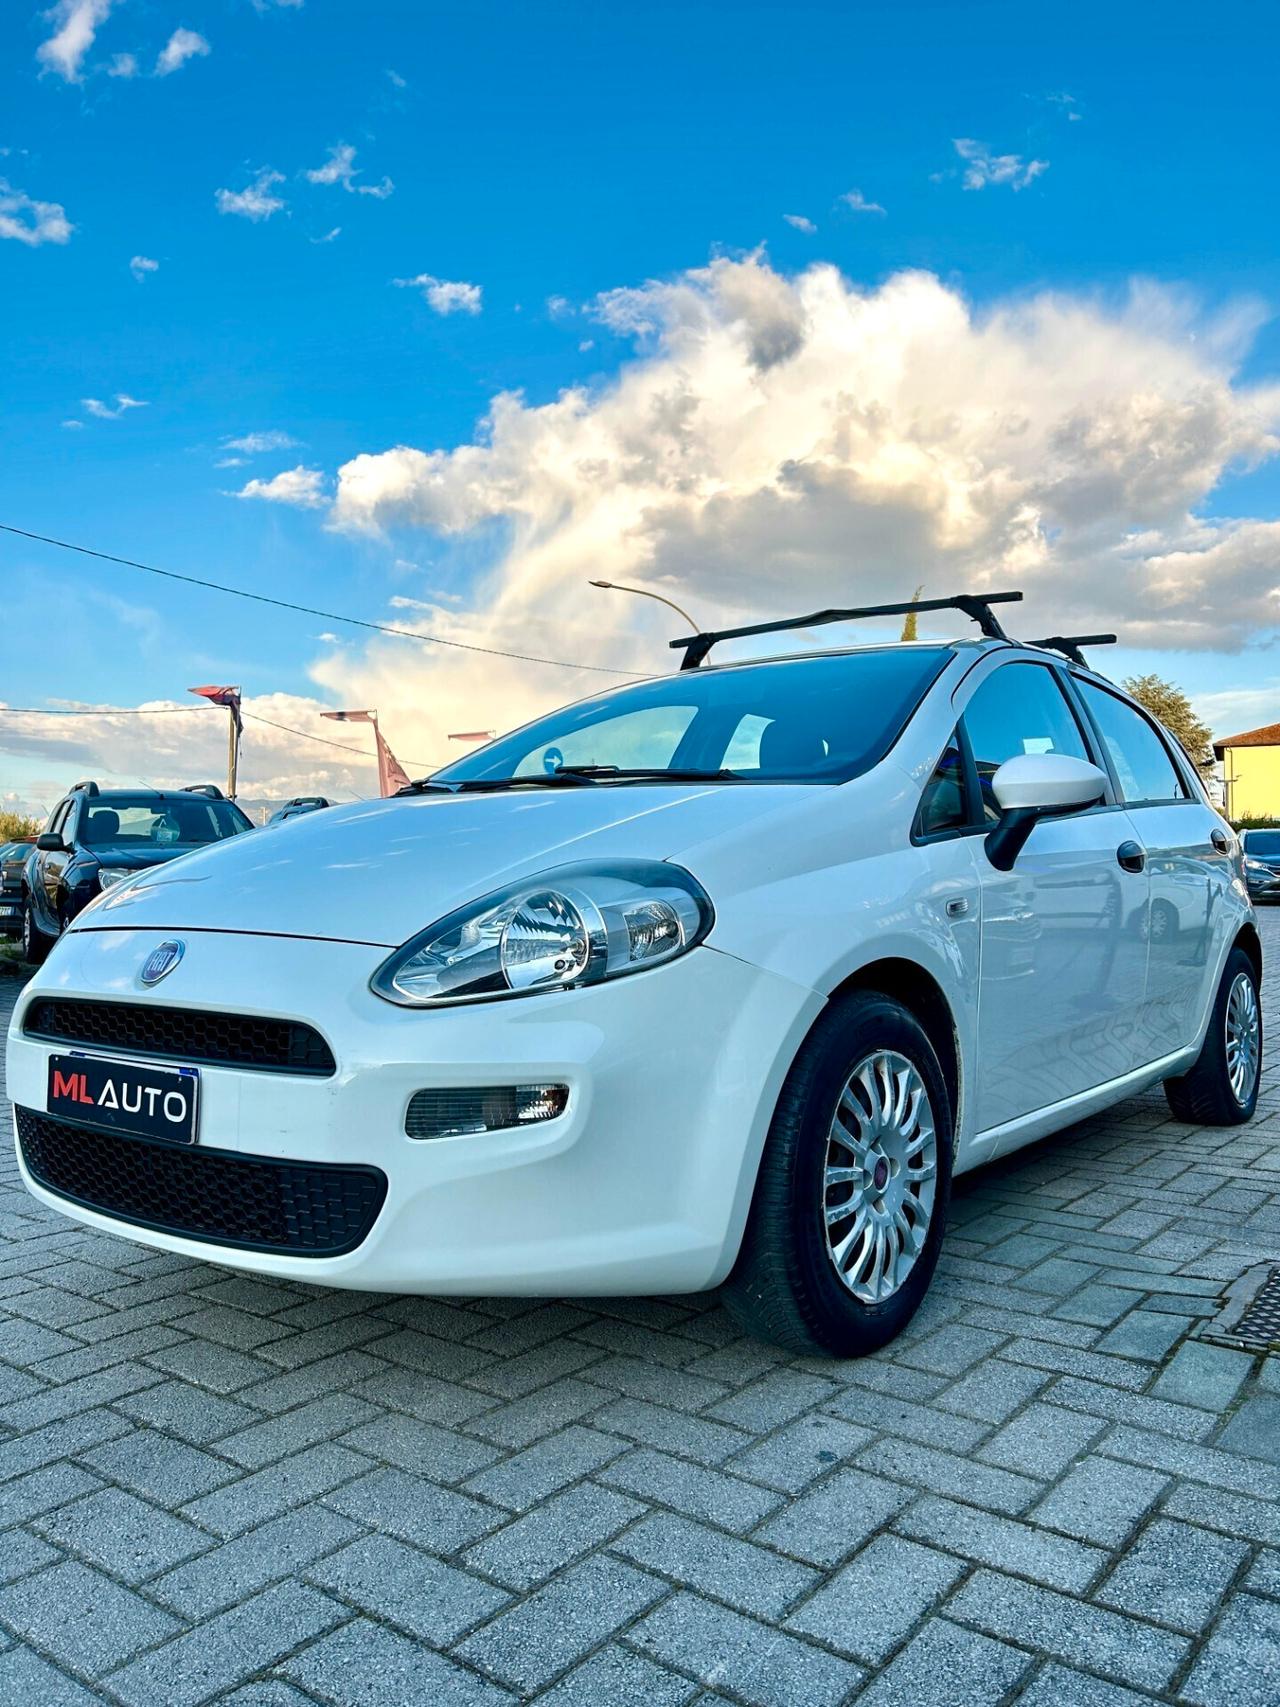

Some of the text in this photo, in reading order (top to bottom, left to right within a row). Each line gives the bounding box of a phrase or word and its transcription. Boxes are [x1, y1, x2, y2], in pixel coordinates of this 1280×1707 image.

[147, 951, 175, 972] FIAT
[53, 1070, 187, 1123] ML AUTO
